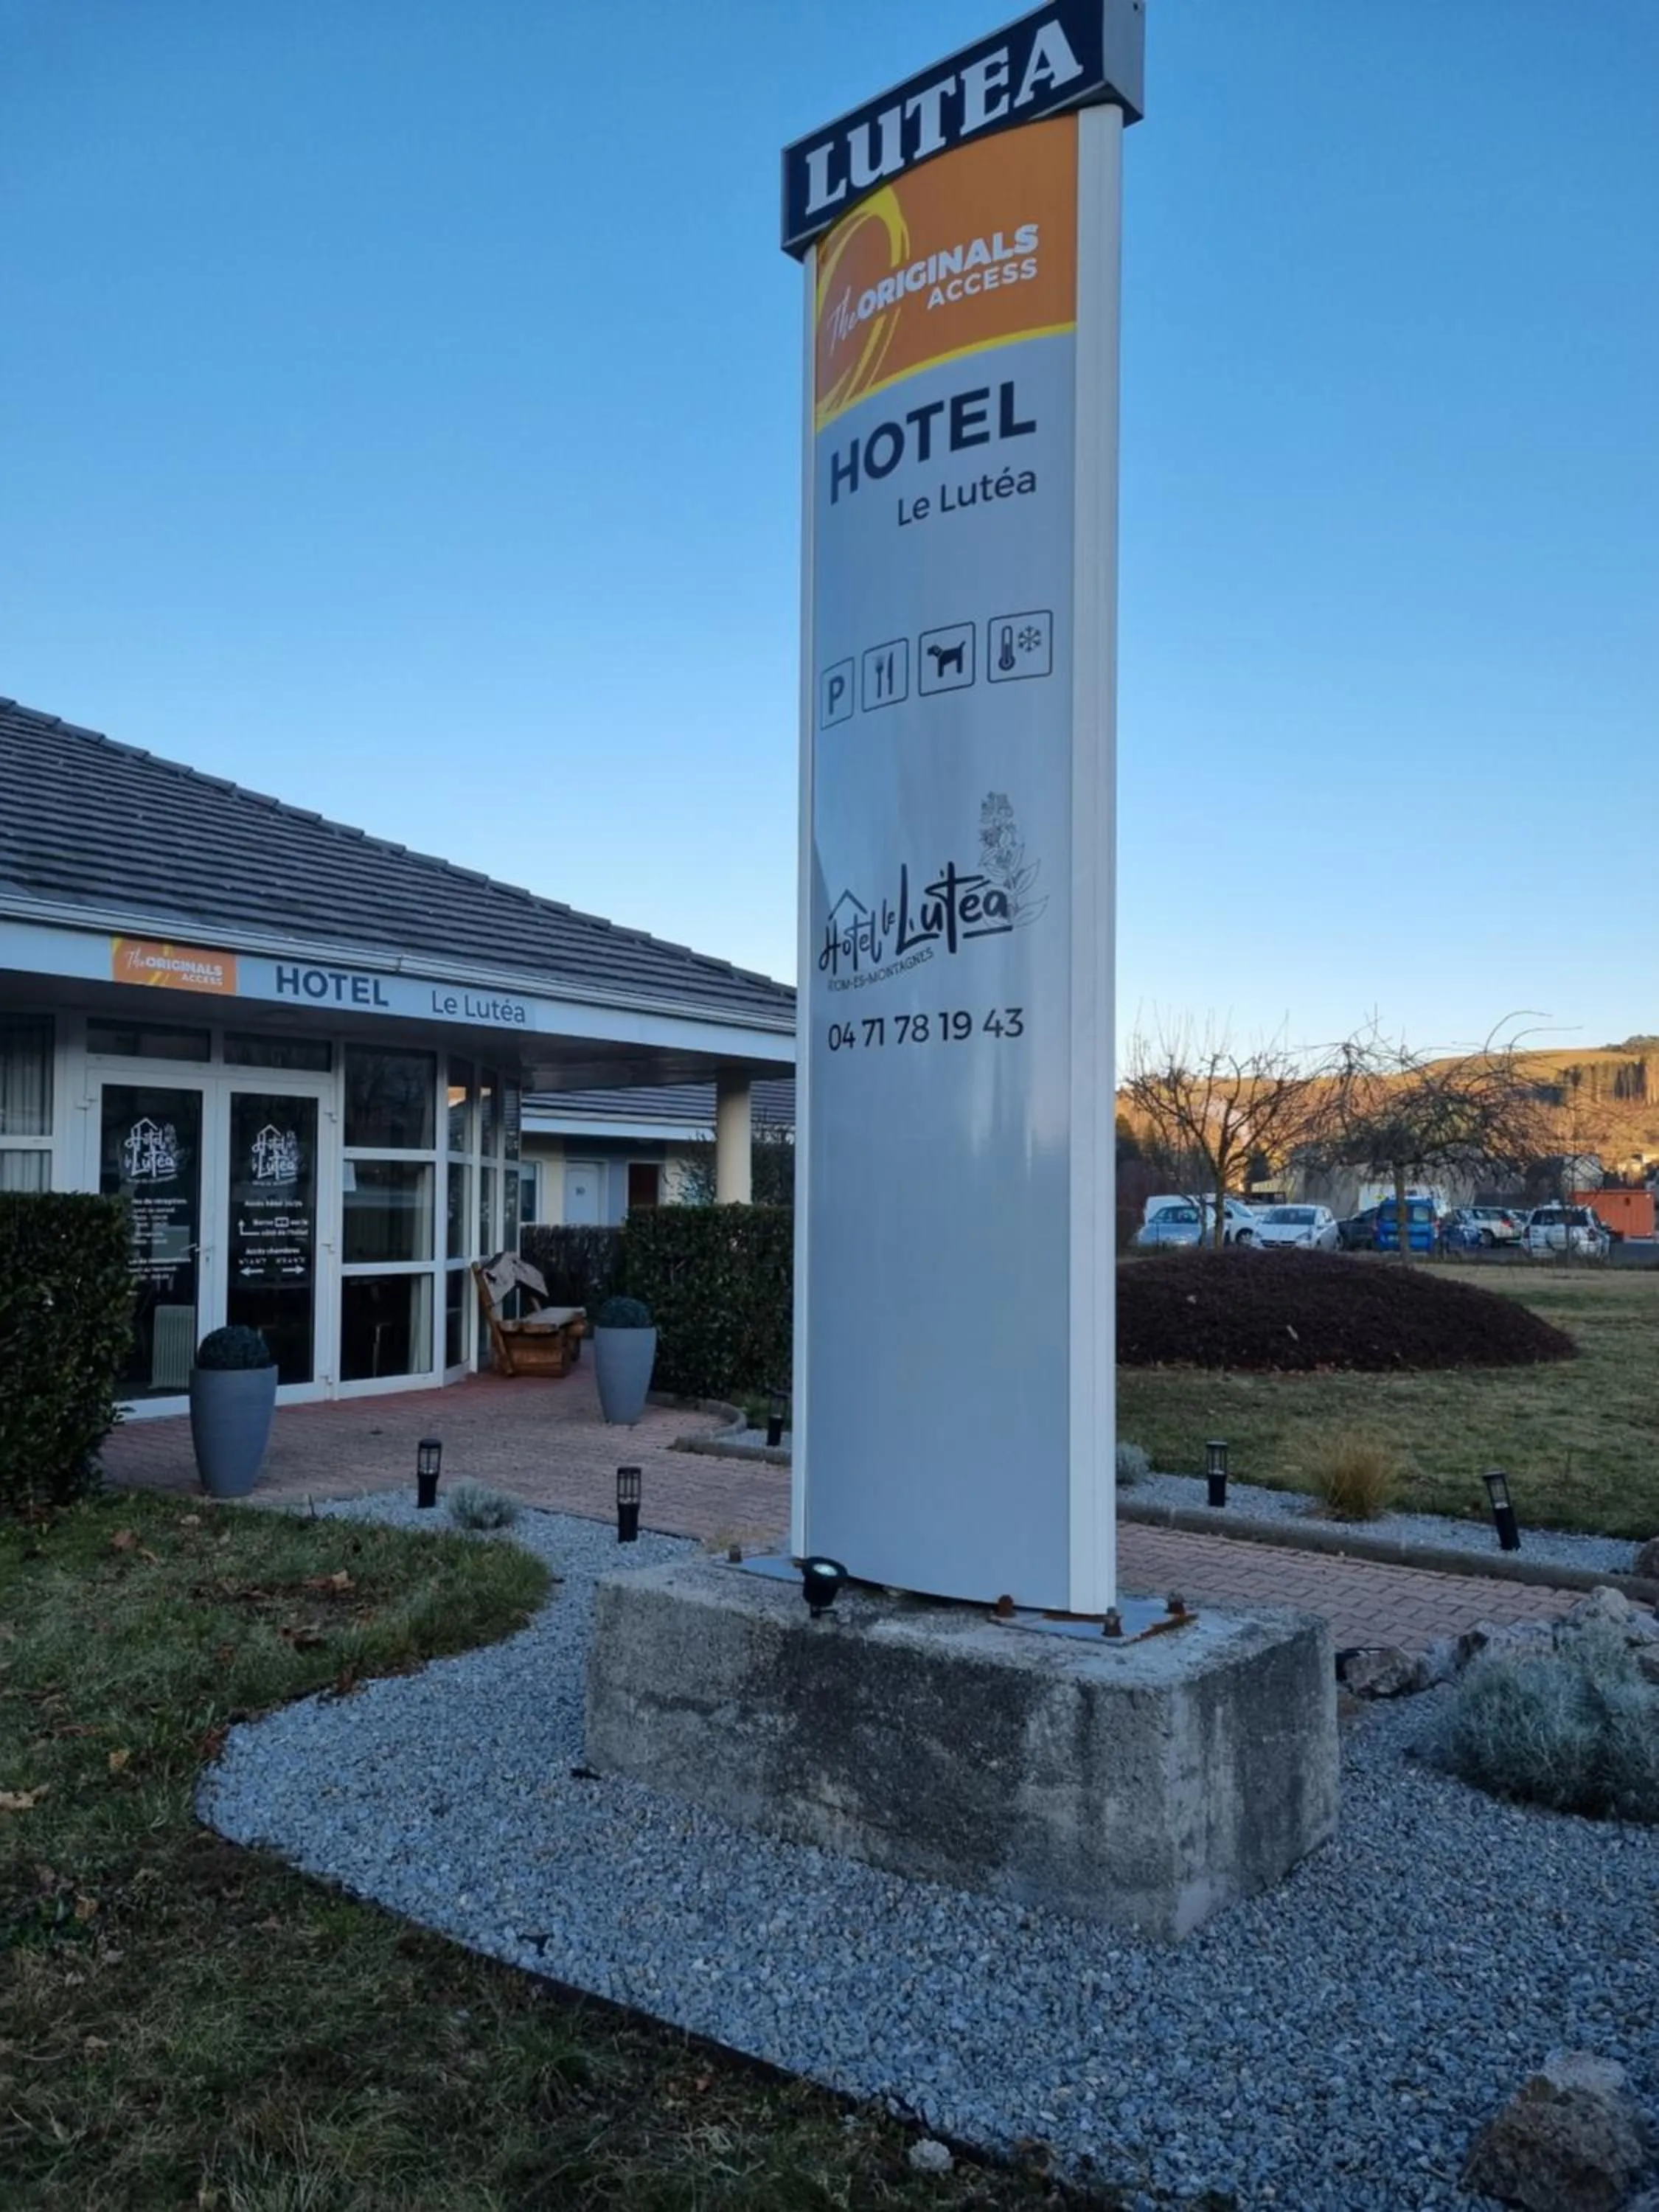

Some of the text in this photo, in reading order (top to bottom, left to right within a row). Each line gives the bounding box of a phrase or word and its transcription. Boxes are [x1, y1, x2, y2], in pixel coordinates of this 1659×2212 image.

[805, 18, 1084, 216] LUTEA
[827, 223, 1040, 359] The ORIGINALS
[927, 258, 1038, 310] ACCESS
[830, 380, 1037, 505] HOTEL
[897, 466, 1037, 526] Le Lutéa
[145, 956, 223, 975] ORIGINALS
[181, 973, 223, 986] ACCESS
[276, 965, 389, 1007] HOTEL
[432, 990, 526, 1023] Le Lutéa
[827, 1007, 1025, 1052] 04 71 78 19 43
